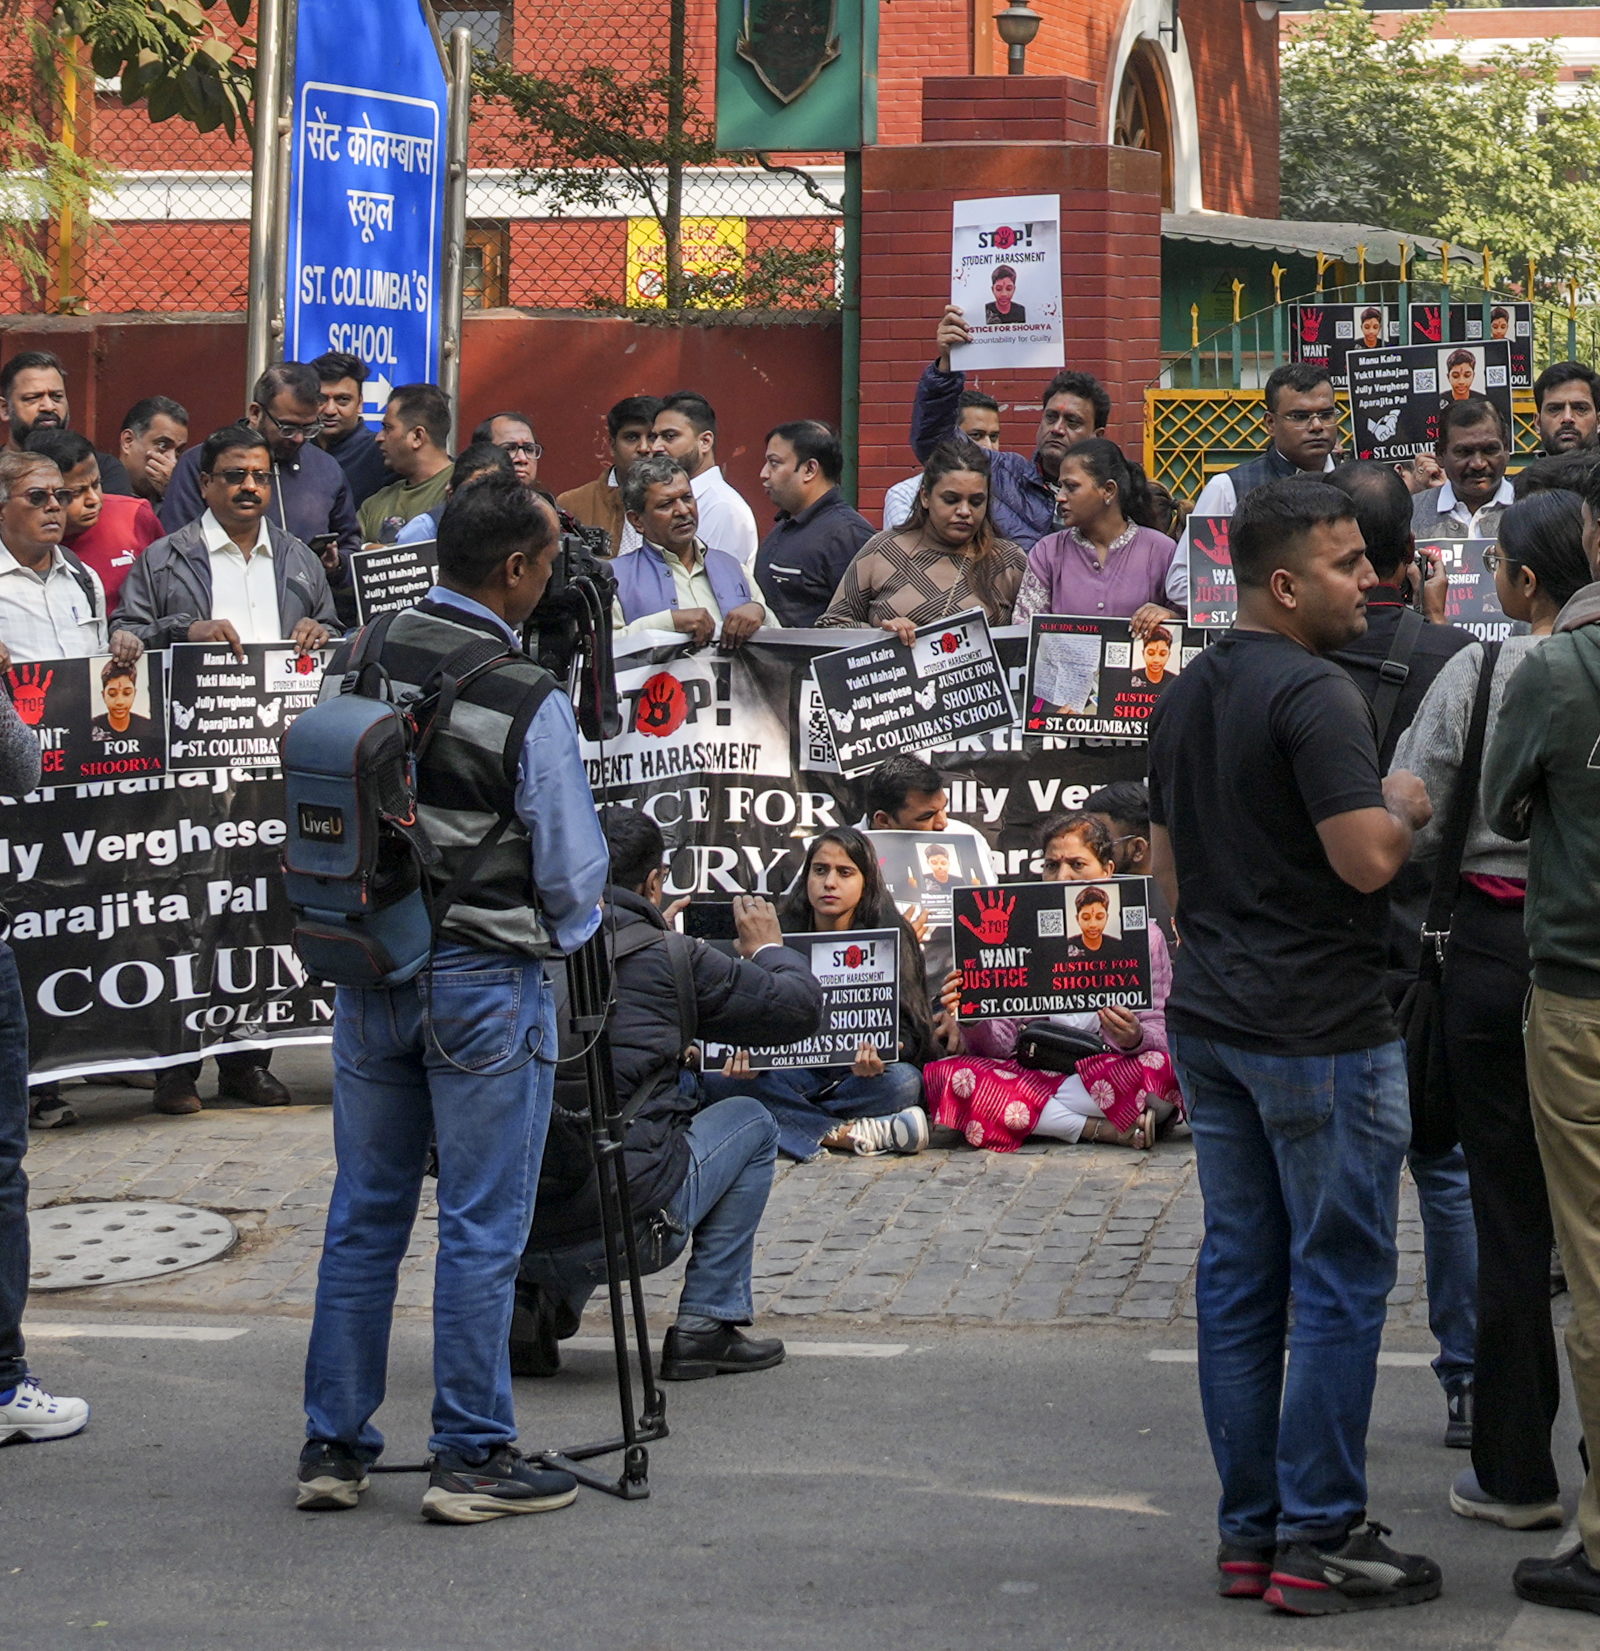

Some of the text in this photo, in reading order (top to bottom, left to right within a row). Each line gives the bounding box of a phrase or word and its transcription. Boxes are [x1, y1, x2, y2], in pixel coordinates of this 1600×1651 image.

[306, 106, 433, 175] सेंट कोलम्बास
[347, 188, 395, 243] स्कूल
[962, 252, 1046, 266] STUDENT HARASSMENT
[301, 265, 427, 313] ST. COLUMBA'S
[995, 323, 1052, 333] FOR SHOURYA
[327, 322, 398, 364] SCHOOL
[970, 335, 1052, 345] ccountability for Guilty
[1359, 355, 1379, 366] Manu
[1354, 370, 1373, 381] Yukti
[1375, 367, 1409, 379] Mahajan
[1374, 382, 1410, 394] Verghese
[1359, 396, 1393, 409] Aparajita
[1373, 447, 1390, 460] ST.
[366, 557, 392, 568] Manu
[388, 566, 428, 581] Mahajan
[388, 580, 430, 595] Verghese
[1211, 610, 1229, 623] ST.
[1040, 623, 1099, 633] SUICIDE NOTE
[203, 653, 225, 665] Manu
[847, 651, 872, 670] Manu
[923, 649, 983, 675] STUDENT HARASSMENT
[196, 674, 256, 689] Yukti Mahajan
[846, 666, 907, 691] Yukti Mahajan
[938, 661, 995, 689] JUSTICE FOR
[273, 681, 297, 690] STUDENT
[217, 696, 256, 711] Verghese
[874, 685, 912, 705] Verghese
[942, 680, 1002, 711] SHOURYA
[197, 716, 254, 733] Aparajita Pal
[859, 704, 915, 731] Aparajita Pal
[1045, 717, 1143, 735] ST. COLUMBA'S
[855, 739, 876, 756] ST.
[876, 716, 951, 751] COLUMBA'S
[952, 700, 1008, 729] SCHOOL
[104, 739, 140, 756] FOR
[188, 740, 207, 757] ST.
[900, 741, 921, 754] GOLE
[922, 733, 953, 749] MARKET
[80, 757, 162, 777] SHOORYA
[230, 757, 252, 766] GOLE
[641, 742, 762, 779] HARASSMENT
[724, 787, 840, 828] FOR
[302, 812, 342, 836] LiveU
[63, 818, 287, 867] Verghese
[207, 877, 268, 915] Pal
[980, 947, 1032, 968] WANT
[1052, 959, 1139, 973] JUSTICE FOR
[819, 971, 885, 986] STUDENT HARASSMENT
[962, 968, 1029, 990] JUSTICE
[1052, 973, 1140, 991] SHOURYA
[831, 986, 893, 1005] JUSTICE FOR
[980, 991, 1147, 1014] ST. COLUMBA'S SCHOOL
[830, 1008, 893, 1030] SHOURYA
[836, 1031, 893, 1052] SCHOOL
[772, 1055, 830, 1066] GOLE MARKET
